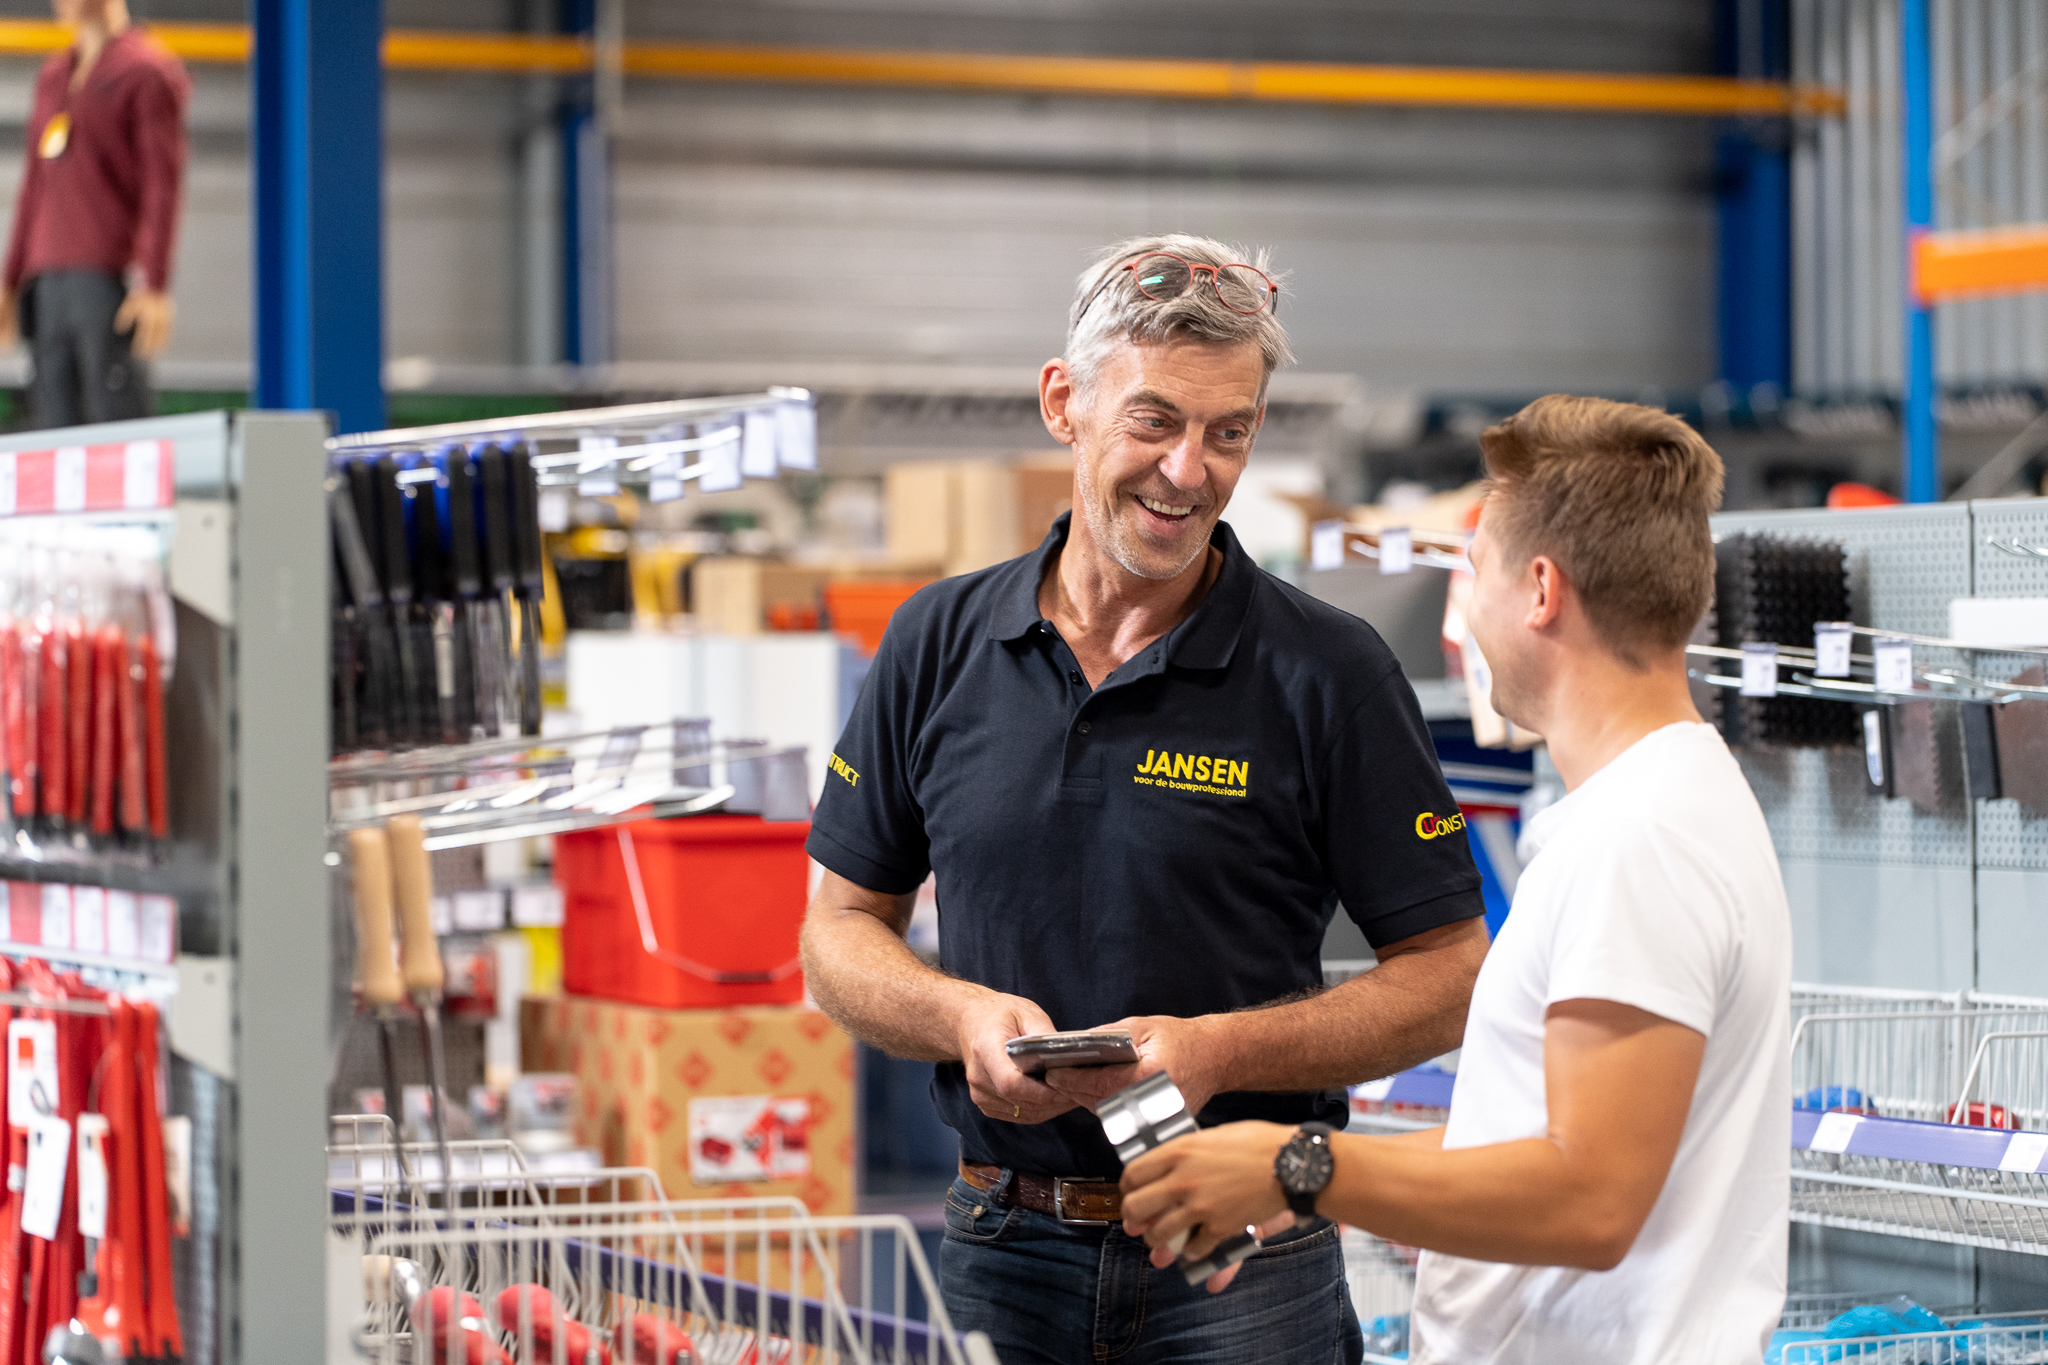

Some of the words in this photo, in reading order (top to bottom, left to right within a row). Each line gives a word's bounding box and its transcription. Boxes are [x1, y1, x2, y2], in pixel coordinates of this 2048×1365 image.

[1137, 749, 1248, 786] JANSEN
[1134, 776, 1154, 785] voor
[1155, 778, 1168, 787] de
[1169, 780, 1246, 797] bouwprofessional
